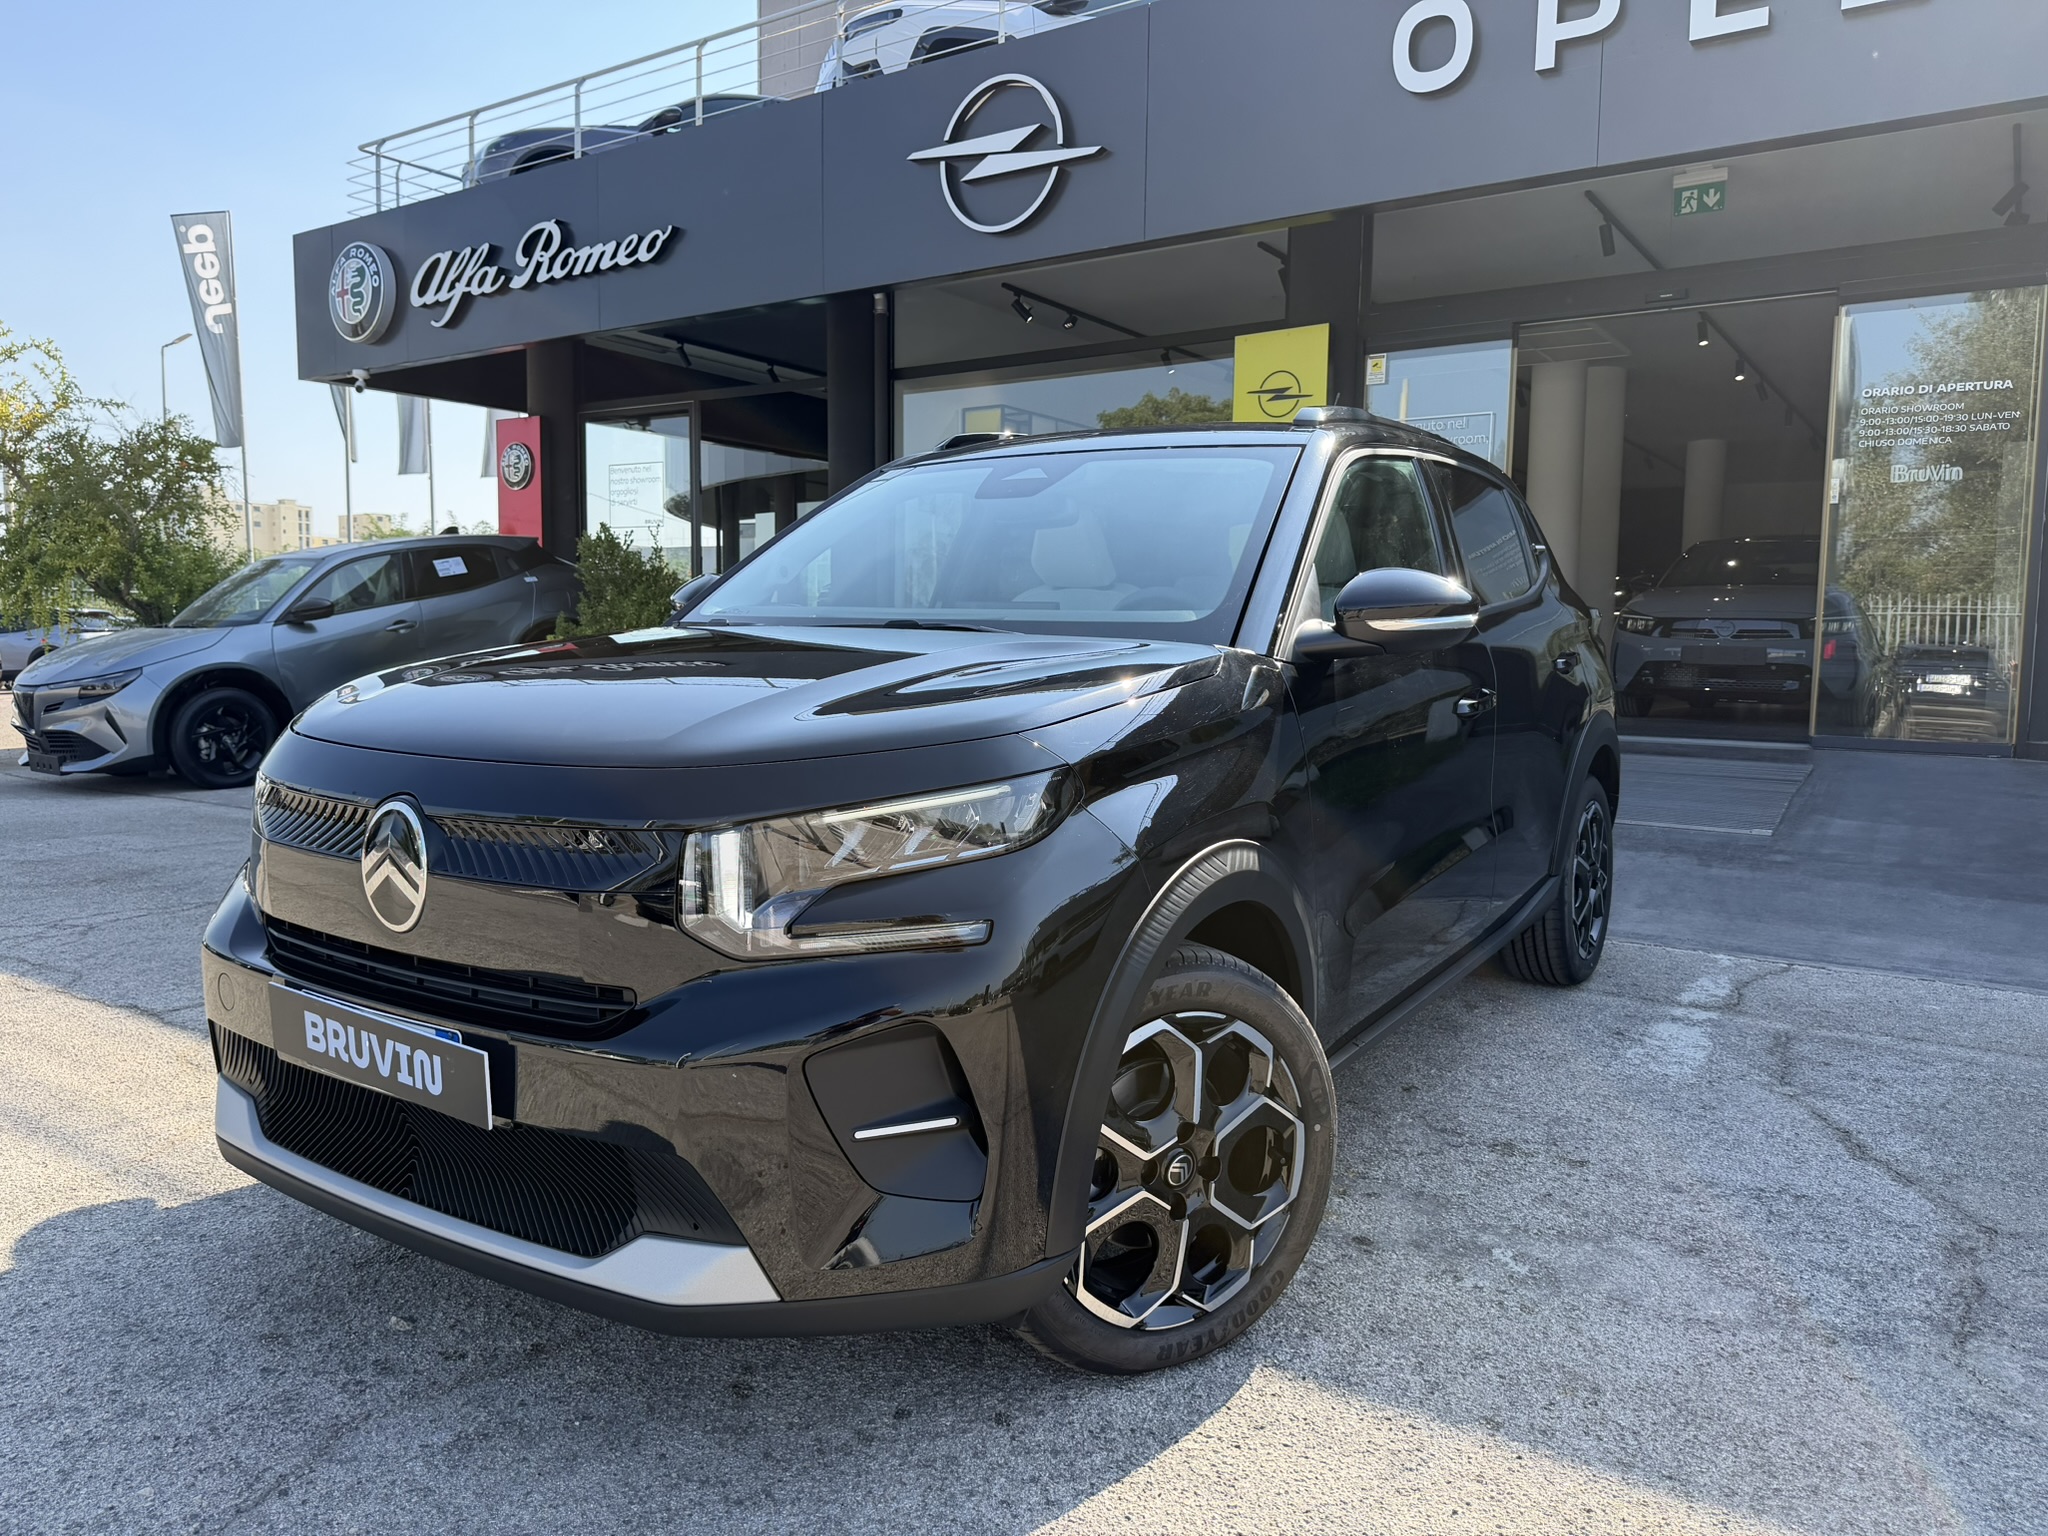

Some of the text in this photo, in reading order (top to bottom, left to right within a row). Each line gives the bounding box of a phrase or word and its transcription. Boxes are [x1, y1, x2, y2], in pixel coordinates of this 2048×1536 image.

[349, 247, 380, 288] ROMEO
[410, 218, 673, 328] Alfa Romeo
[1862, 379, 2014, 398] ORARIO DI APERTURA
[1860, 402, 1965, 416] ORARIO SHOWROOM
[1447, 416, 1466, 429] nel
[1969, 422, 2011, 433] SABATO
[1858, 436, 1953, 448] CHIUSO DOMENICA
[1148, 981, 1213, 1006] YEAR
[304, 1010, 443, 1096] BRUVIN
